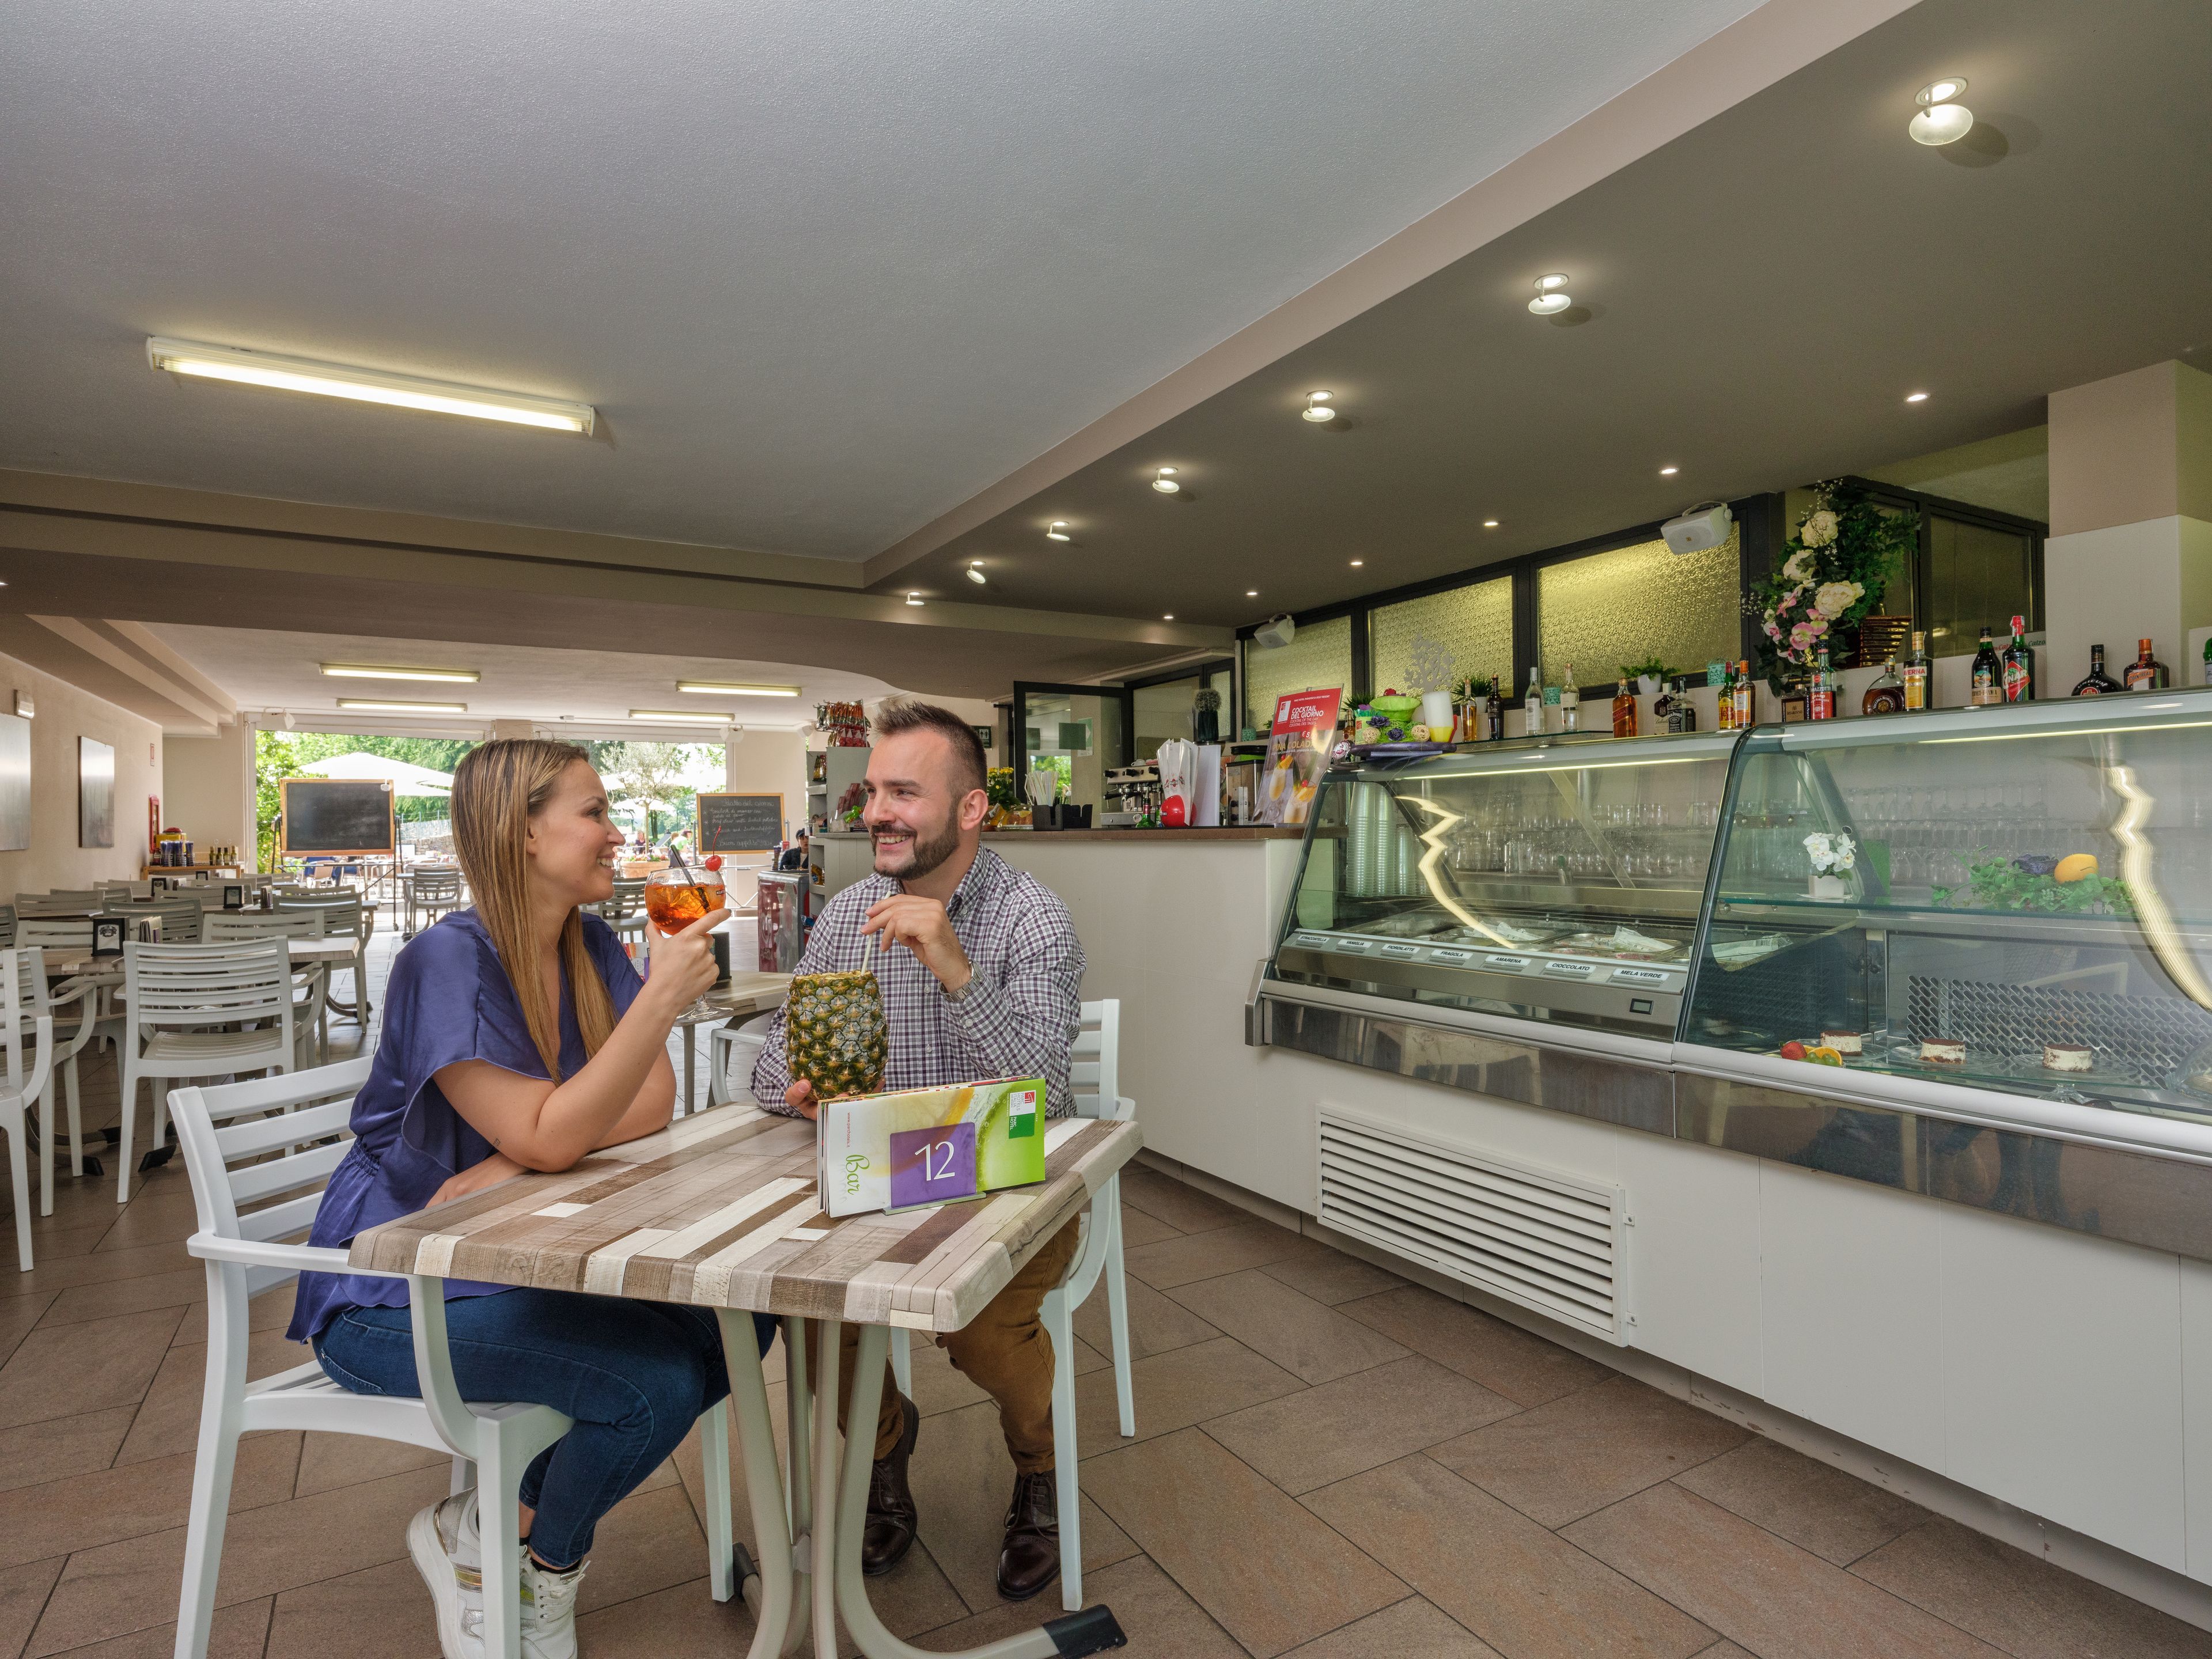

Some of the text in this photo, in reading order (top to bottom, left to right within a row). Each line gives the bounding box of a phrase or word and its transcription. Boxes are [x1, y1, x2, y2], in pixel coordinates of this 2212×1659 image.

[2129, 670, 2152, 683] COINTREAU
[1292, 706, 1316, 714] COCKTAIL
[1552, 963, 1590, 971] CIOCCOLATO
[914, 1141, 955, 1181] 12
[846, 1154, 870, 1195] Bar
